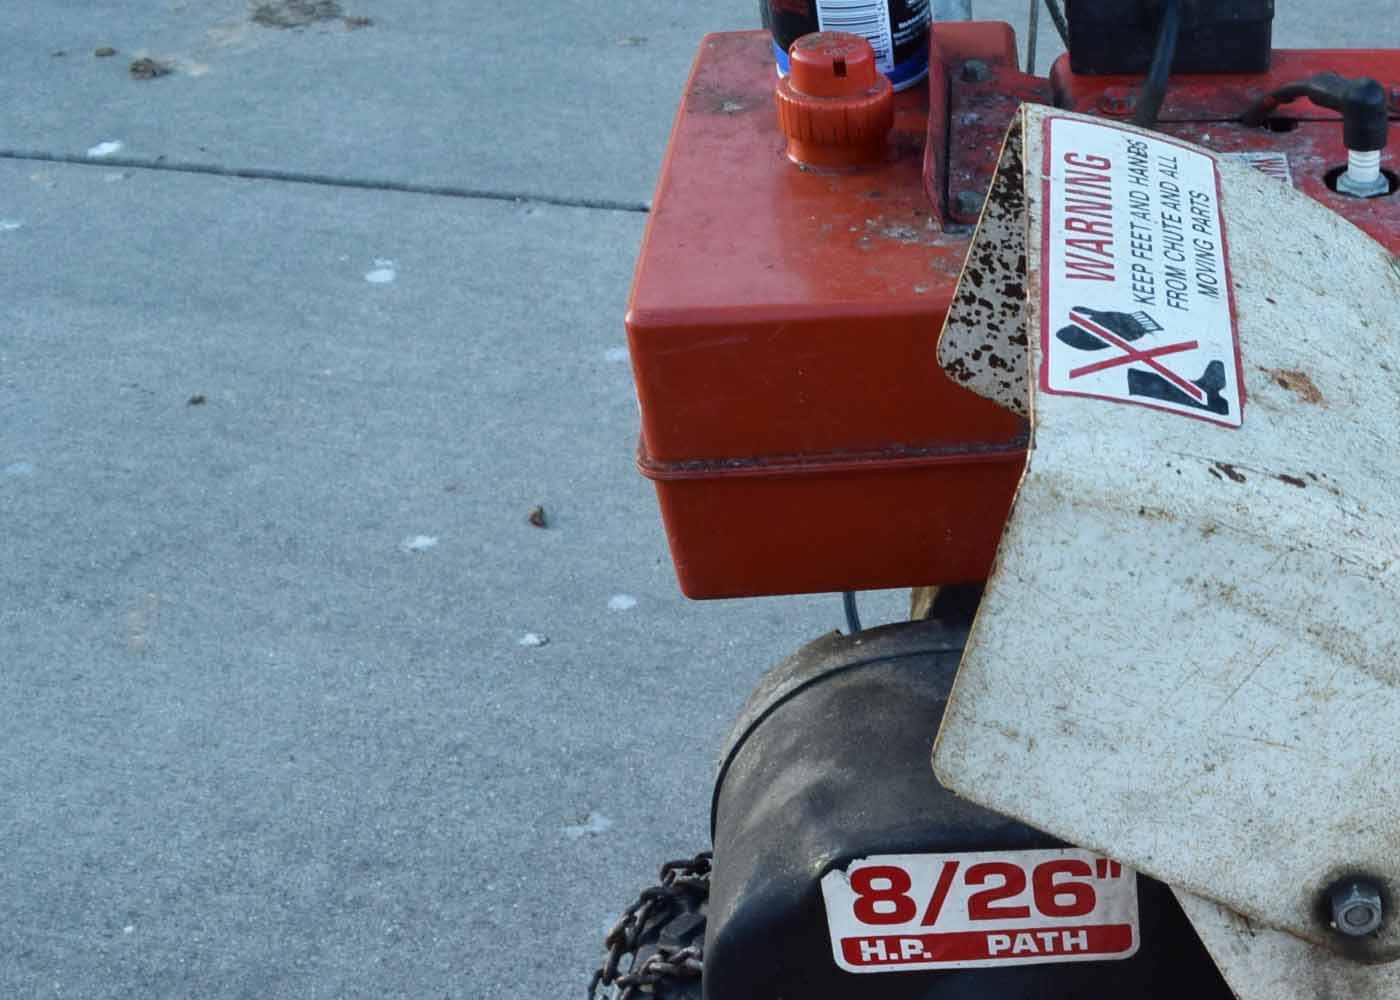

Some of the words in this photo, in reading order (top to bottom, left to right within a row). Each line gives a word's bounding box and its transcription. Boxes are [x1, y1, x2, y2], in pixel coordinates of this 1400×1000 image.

[1126, 139, 1150, 188] HANDS
[1158, 155, 1179, 179] ALL
[1063, 152, 1116, 283] WARNING
[1128, 191, 1151, 221] AND
[1161, 182, 1182, 212] AND
[1188, 189, 1213, 236] PARTS
[1129, 224, 1154, 262] FEET
[1161, 212, 1187, 263] CHUTE
[1131, 263, 1157, 306] KEEP
[1165, 267, 1189, 312] FROM
[1193, 239, 1219, 300] MOVING
[849, 859, 1122, 926] 8/26"
[860, 939, 932, 962] H.P.
[987, 930, 1088, 956] PATH
